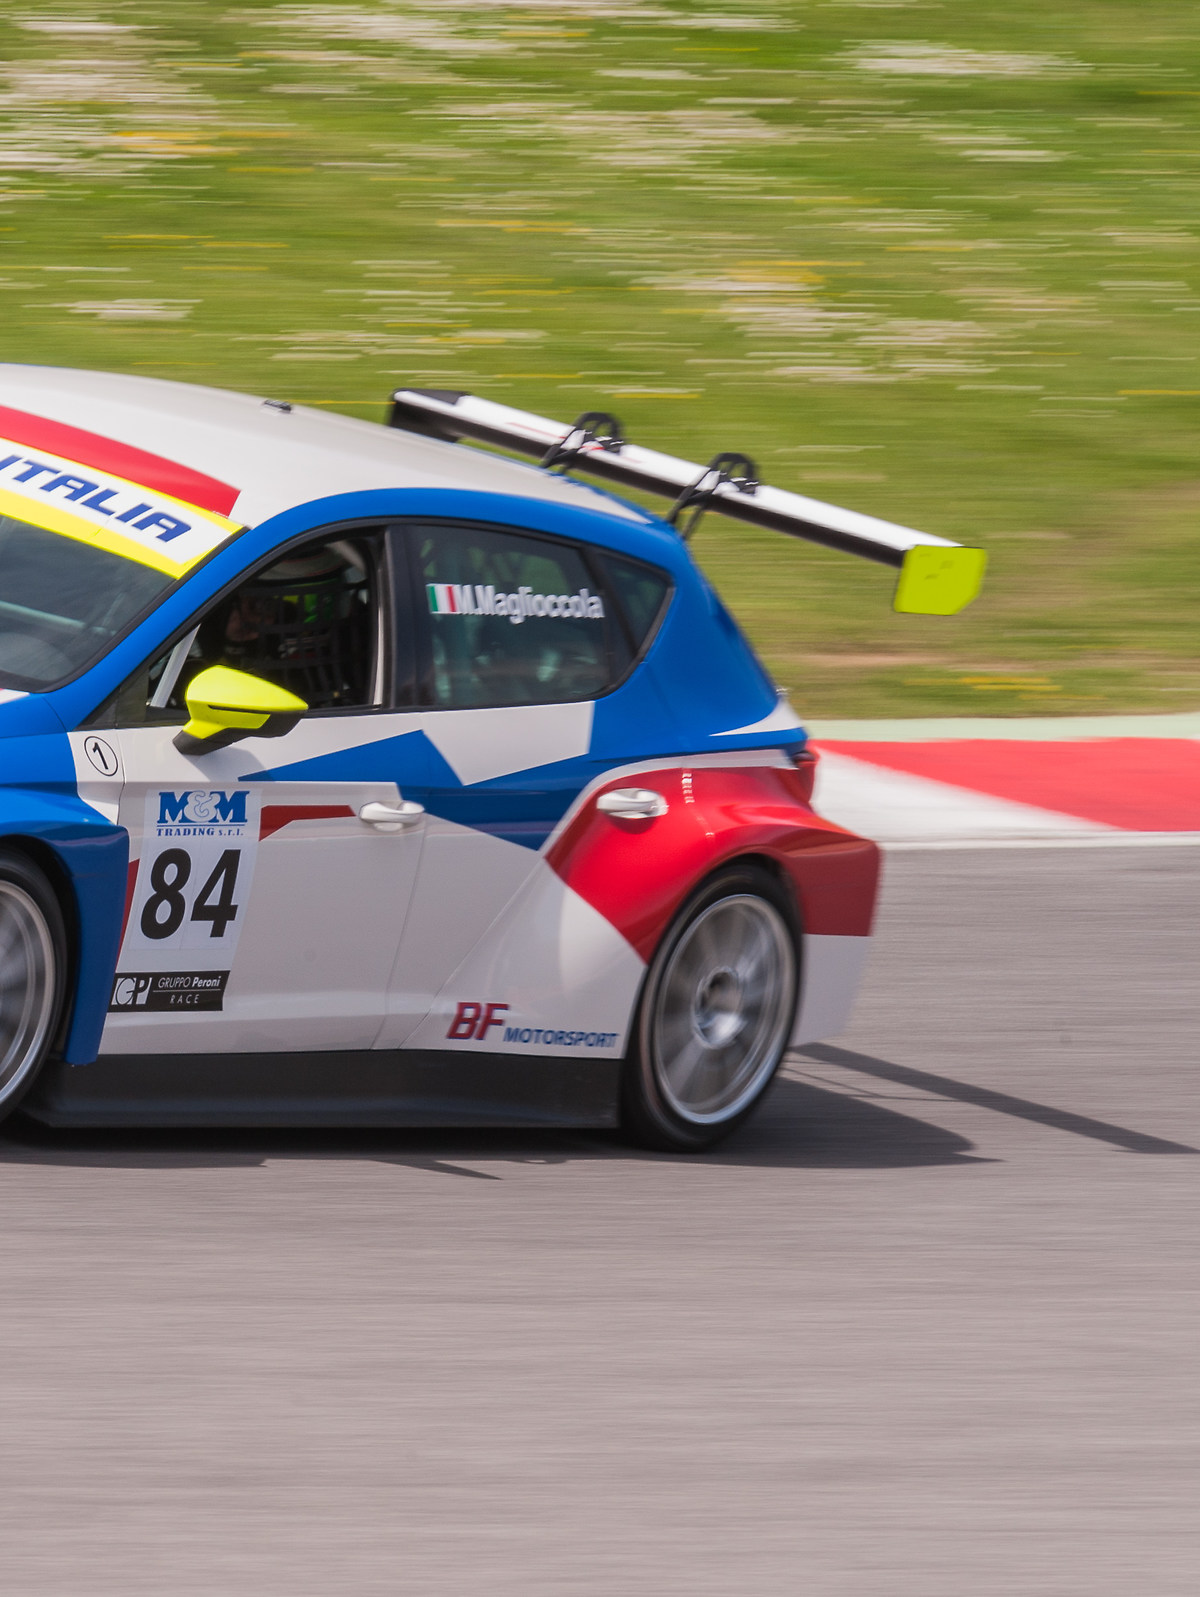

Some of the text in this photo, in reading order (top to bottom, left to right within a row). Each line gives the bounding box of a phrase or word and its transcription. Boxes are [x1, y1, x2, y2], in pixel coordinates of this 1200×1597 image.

[92, 742, 109, 770] 1
[156, 790, 250, 824] M&M
[156, 827, 215, 837] TRADING
[140, 848, 242, 940] 84
[157, 976, 222, 989] GRUPPO Peroni
[169, 994, 200, 1004] RACE
[446, 1002, 620, 1048] BF MOTORSPORT
